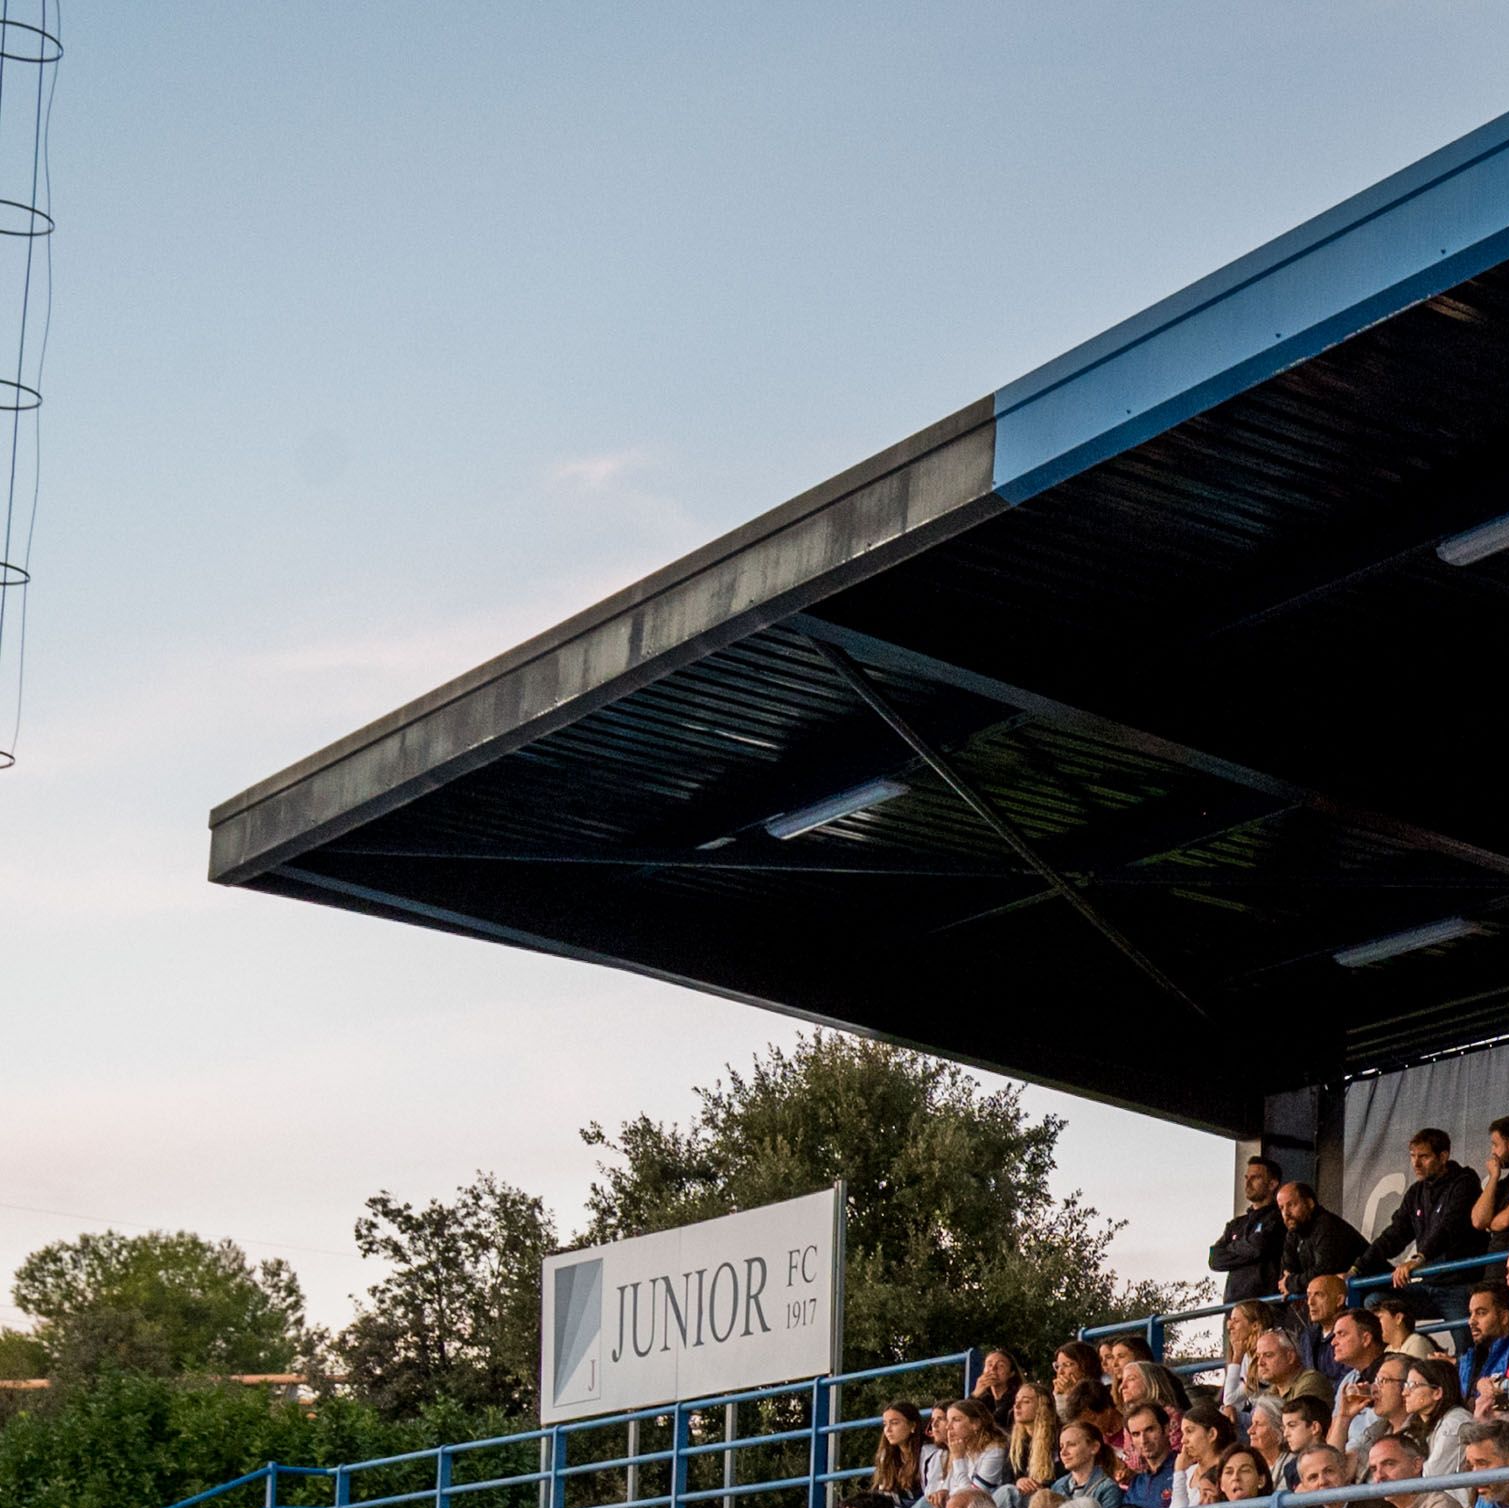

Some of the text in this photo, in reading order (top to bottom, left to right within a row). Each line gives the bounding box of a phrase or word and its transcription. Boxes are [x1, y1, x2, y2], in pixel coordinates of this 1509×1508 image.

[786, 1245, 818, 1288] FC
[612, 1256, 771, 1363] JUNIOR
[786, 1298, 817, 1329] 1917
